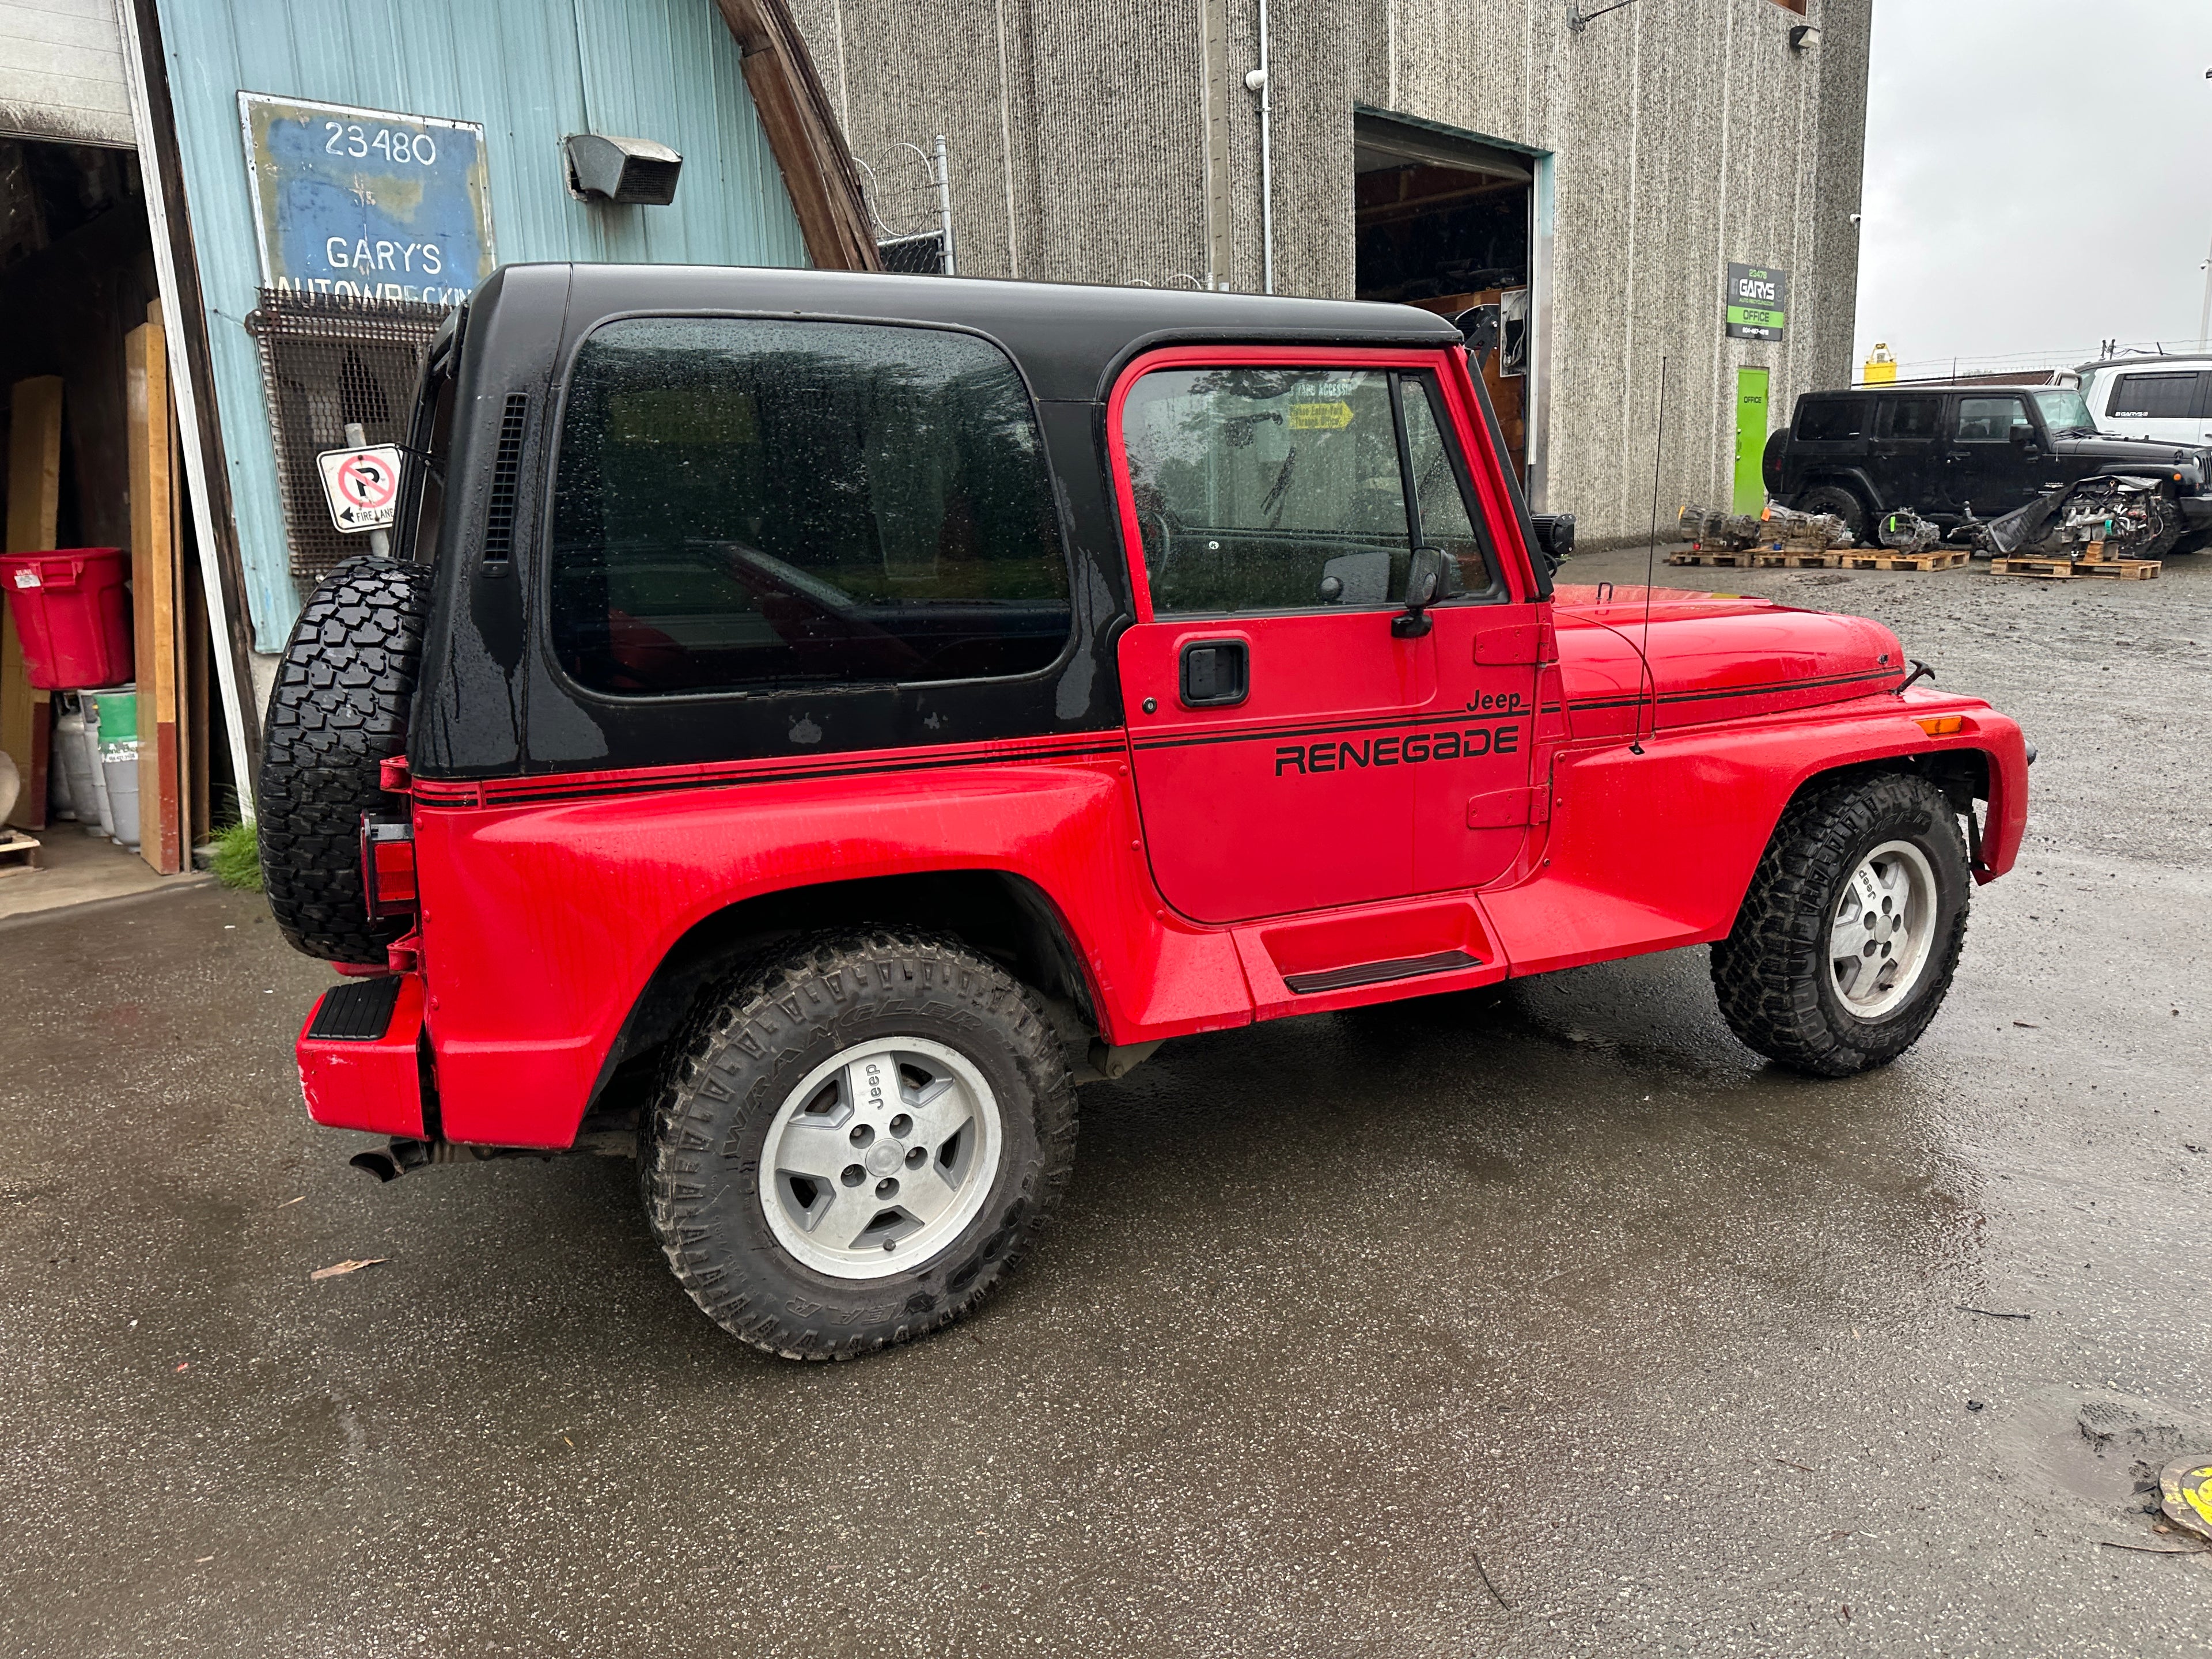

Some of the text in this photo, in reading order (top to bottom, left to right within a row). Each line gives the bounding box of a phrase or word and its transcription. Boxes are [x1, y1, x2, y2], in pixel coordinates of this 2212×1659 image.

[325, 122, 436, 165] 23480
[326, 237, 441, 274] GARY'S
[1739, 279, 1775, 300] GARYS
[1743, 309, 1770, 323] OFFICE
[356, 508, 393, 522] FIRE LANE
[1466, 689, 1521, 712] Jeep
[1858, 870, 1876, 900] Jeep
[721, 998, 983, 1157] WRANGLER
[866, 1064, 884, 1111] Jeep
